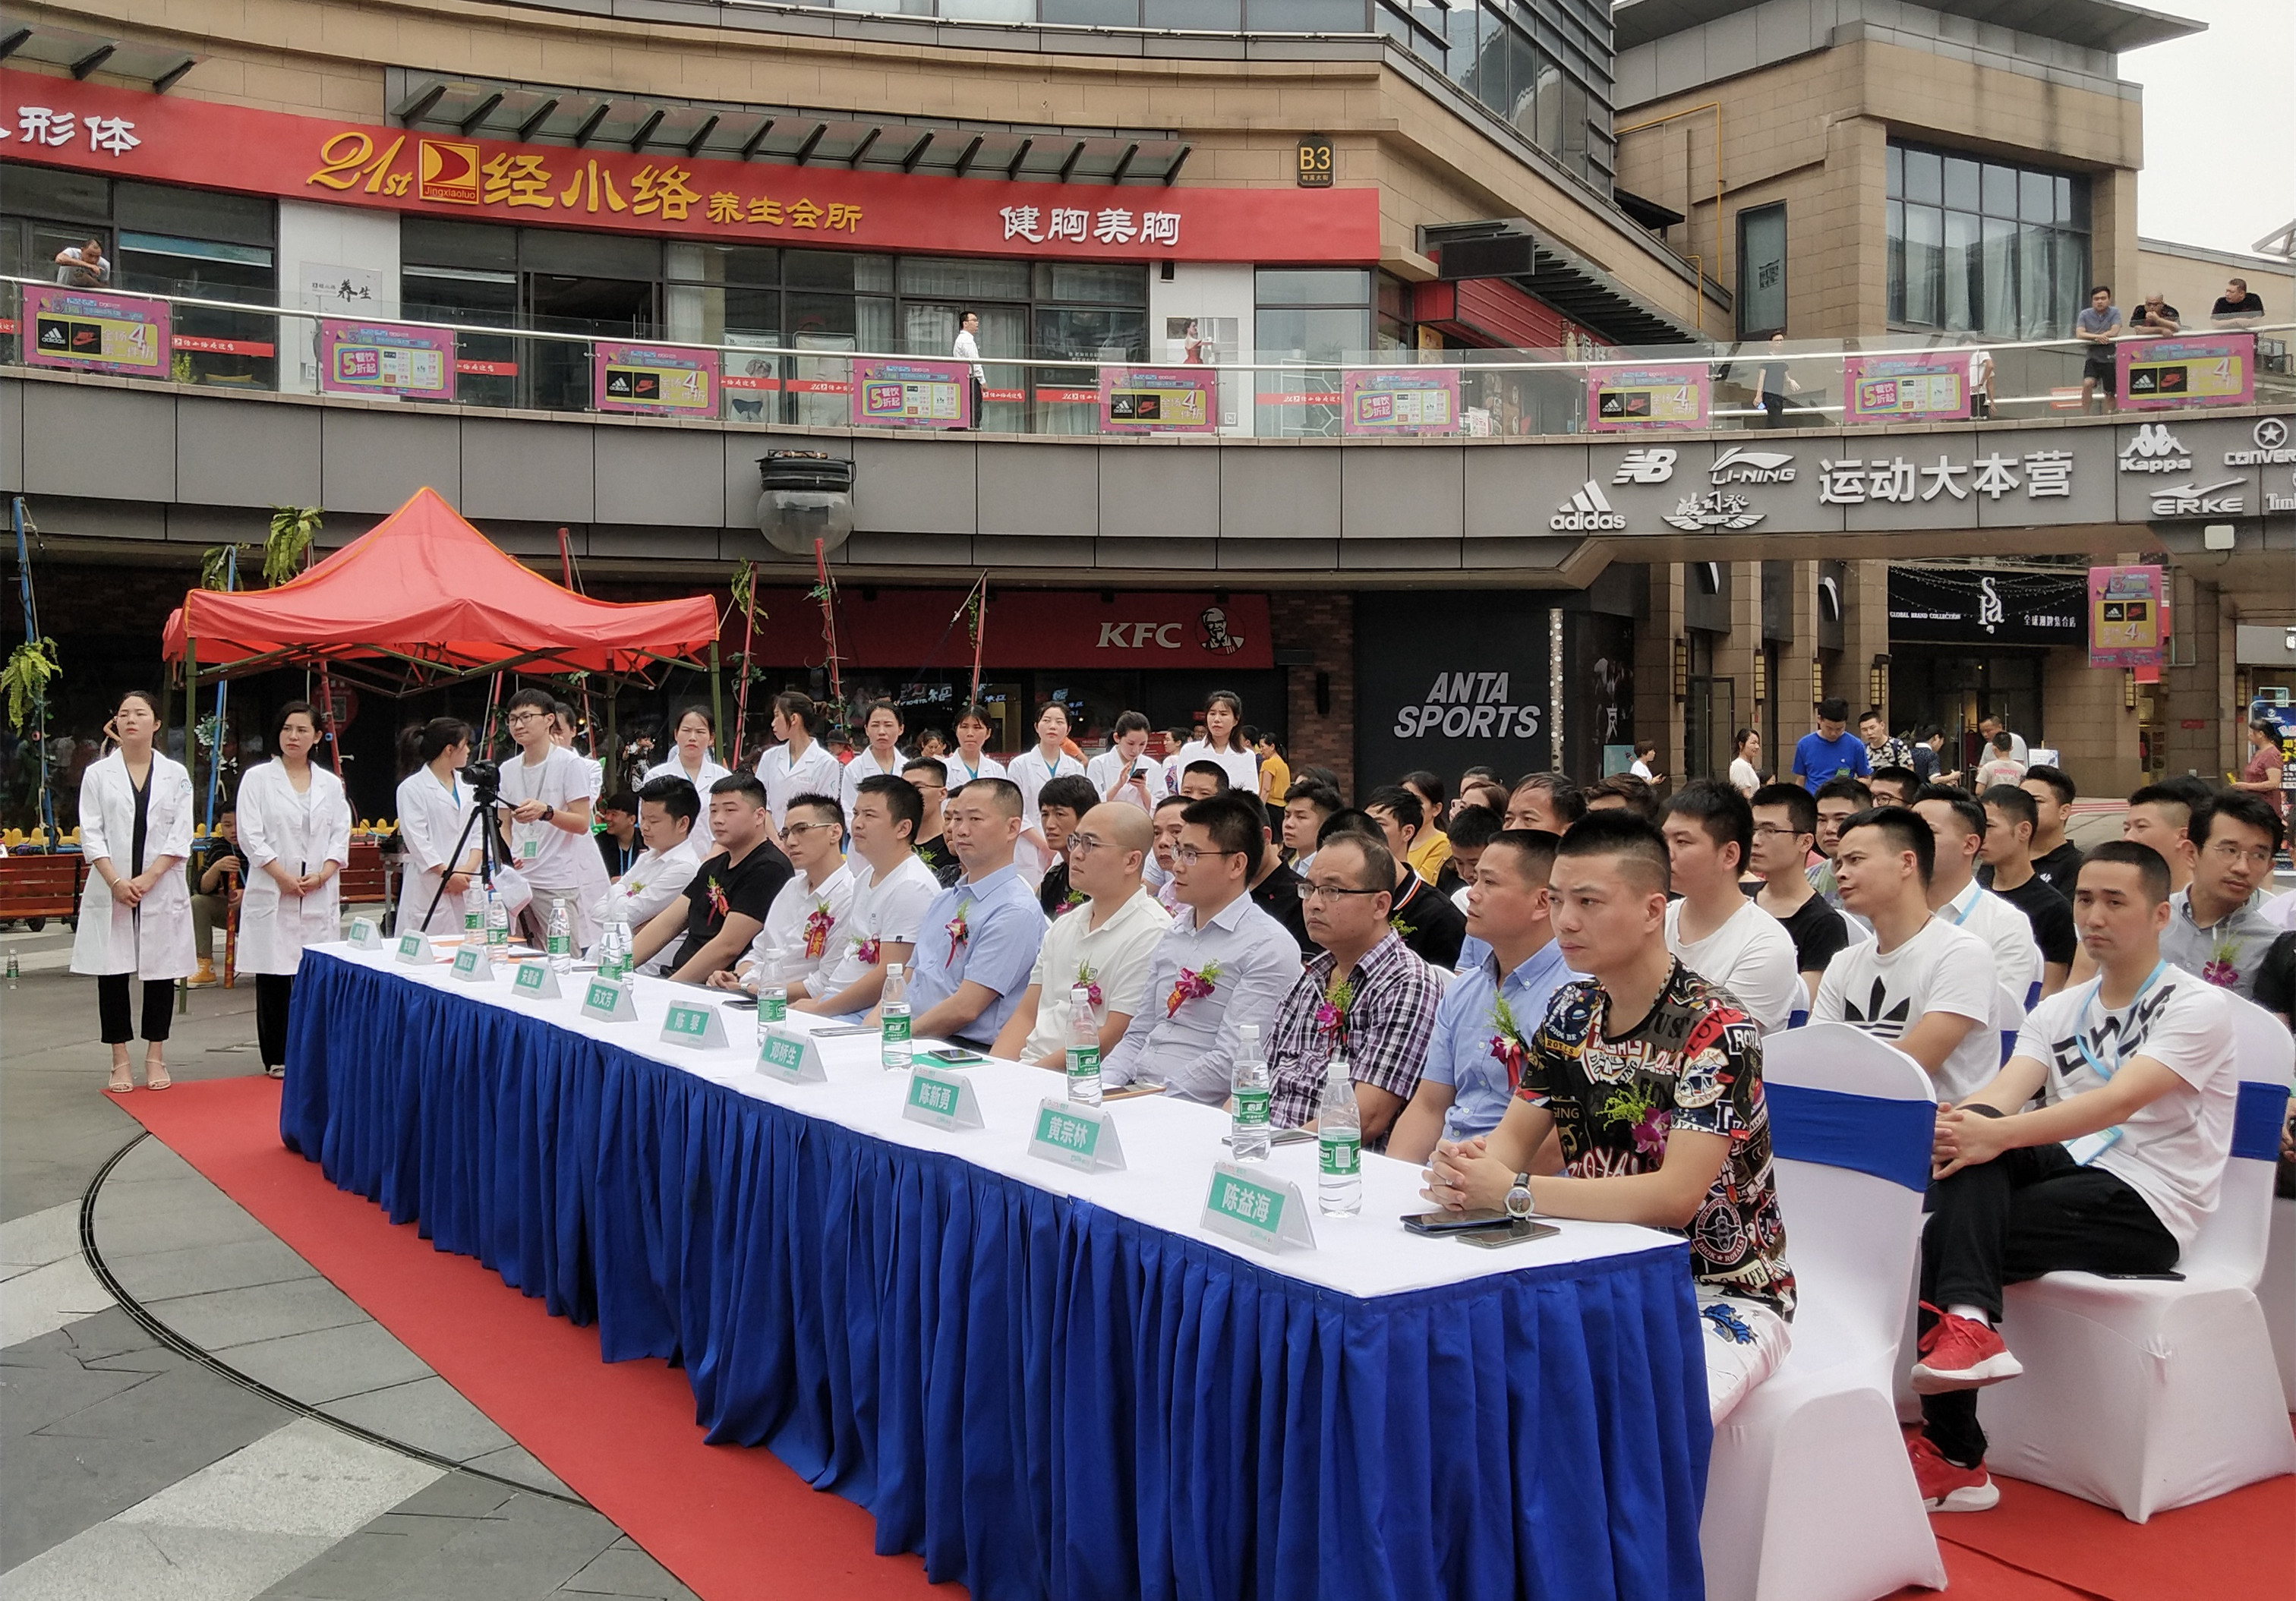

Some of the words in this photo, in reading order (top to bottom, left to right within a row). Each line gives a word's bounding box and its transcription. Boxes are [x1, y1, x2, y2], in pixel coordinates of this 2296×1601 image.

[0, 106, 142, 156] 形体
[305, 131, 413, 197] 21st
[1300, 147, 1330, 170] B3
[481, 152, 702, 221] 经小络
[705, 191, 863, 233] 养生会所
[998, 204, 1181, 246] 健胸美胸
[337, 279, 372, 303] 养生
[41, 336, 66, 345] adidas
[128, 323, 147, 349] 4
[343, 352, 356, 375] 5
[355, 351, 375, 362] 餐饮
[355, 362, 377, 374] 折起
[2212, 356, 2232, 382] 4
[683, 370, 699, 394] 4
[871, 388, 883, 408] 5
[882, 387, 900, 396] 餐饮
[883, 396, 901, 407] 折起
[1161, 397, 1181, 408] 全场
[1181, 390, 1197, 412] 4
[1673, 386, 1689, 410] 4
[1863, 385, 1877, 406] 5
[1875, 383, 1894, 394] 餐饮
[1876, 392, 1896, 404] 折起
[1361, 399, 1374, 418] 5
[1373, 396, 1390, 407] 餐饮
[1373, 406, 1391, 417] 折起
[1711, 468, 1797, 485] LI-NING
[1818, 449, 2074, 504] 运动大本营
[2119, 457, 2192, 474] Kappa
[1675, 490, 1749, 515] 波司登
[2151, 497, 2244, 515] ERKE
[1550, 512, 1626, 531] adidas
[1096, 622, 1183, 649] KFC
[2124, 622, 2138, 641] 4
[1425, 672, 1509, 704] ANTA
[1392, 704, 1542, 739] SPORTS
[918, 1083, 951, 1111] 陈新勇
[1047, 1116, 1089, 1149] 黄宗林
[1221, 1182, 1272, 1224] 陈益海
